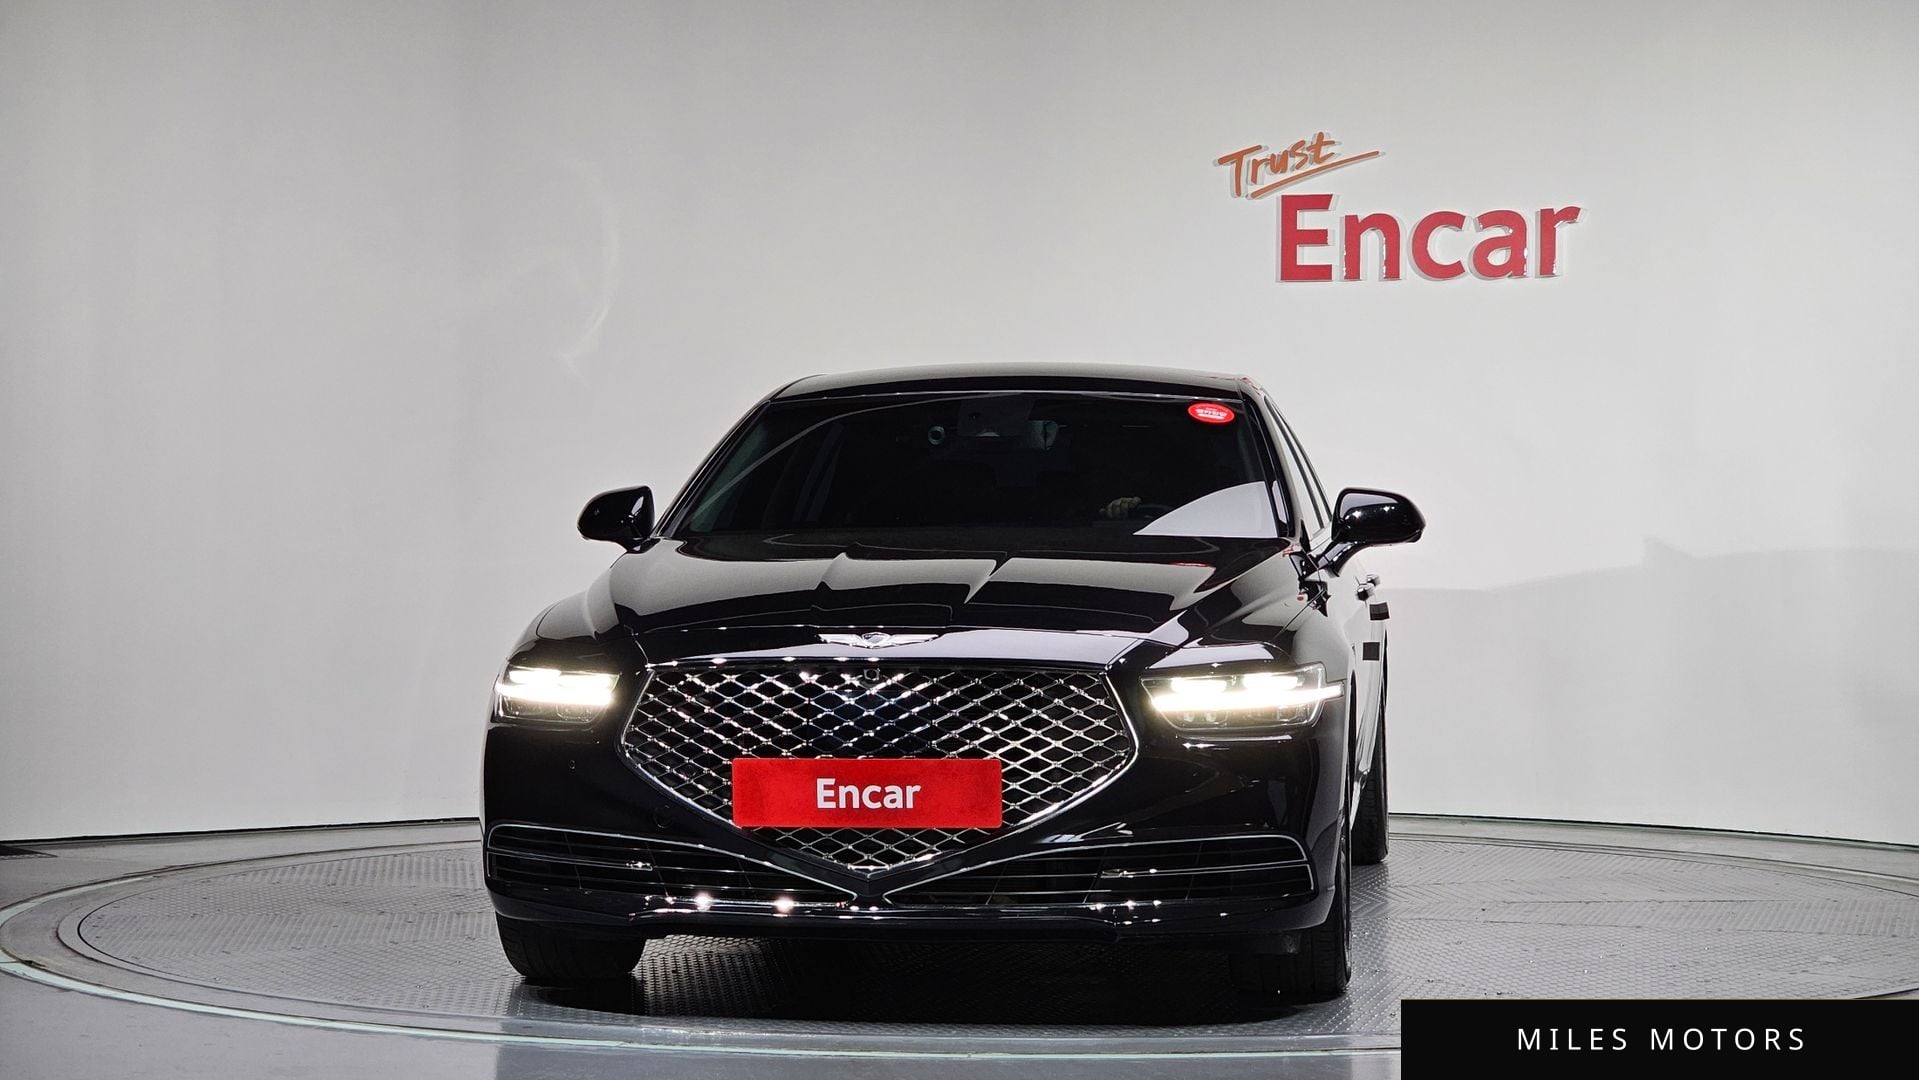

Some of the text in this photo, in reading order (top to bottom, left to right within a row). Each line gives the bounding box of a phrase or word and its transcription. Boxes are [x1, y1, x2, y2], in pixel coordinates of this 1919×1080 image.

[1217, 131, 1337, 197] Trust
[1279, 193, 1582, 281] Encar
[816, 778, 921, 809] Encar
